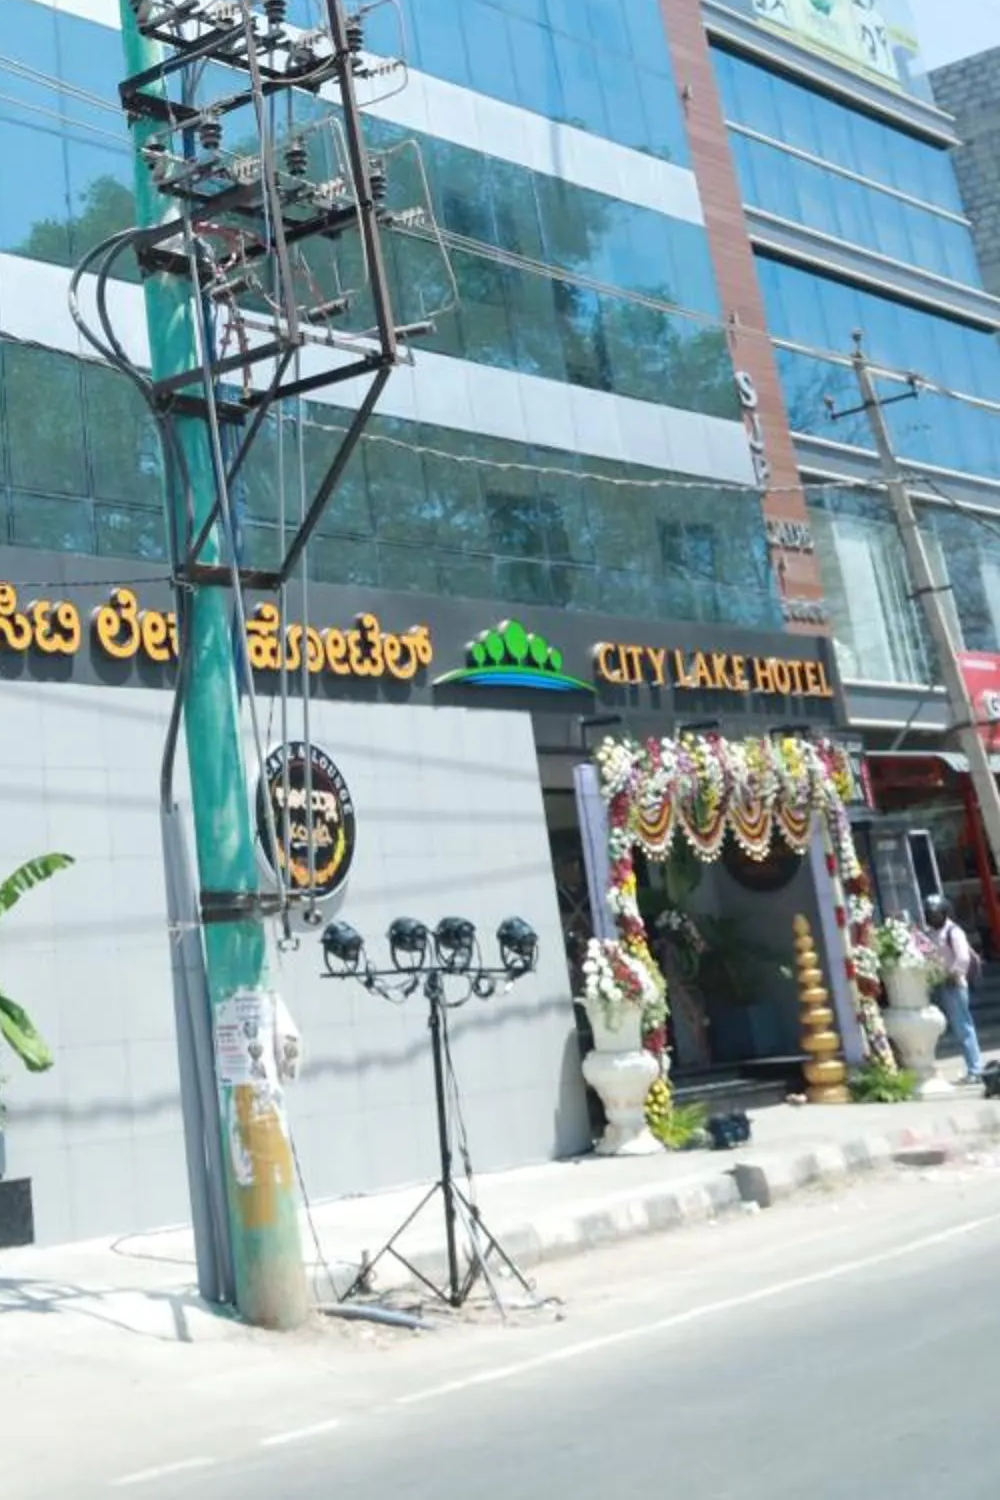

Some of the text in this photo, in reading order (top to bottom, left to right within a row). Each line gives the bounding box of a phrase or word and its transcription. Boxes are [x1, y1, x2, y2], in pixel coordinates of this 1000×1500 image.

[94, 587, 179, 661] ಲೇ
[246, 602, 433, 679] ಹೋಟೆಲ್
[597, 642, 833, 697] CITY LAKE HOTEL
